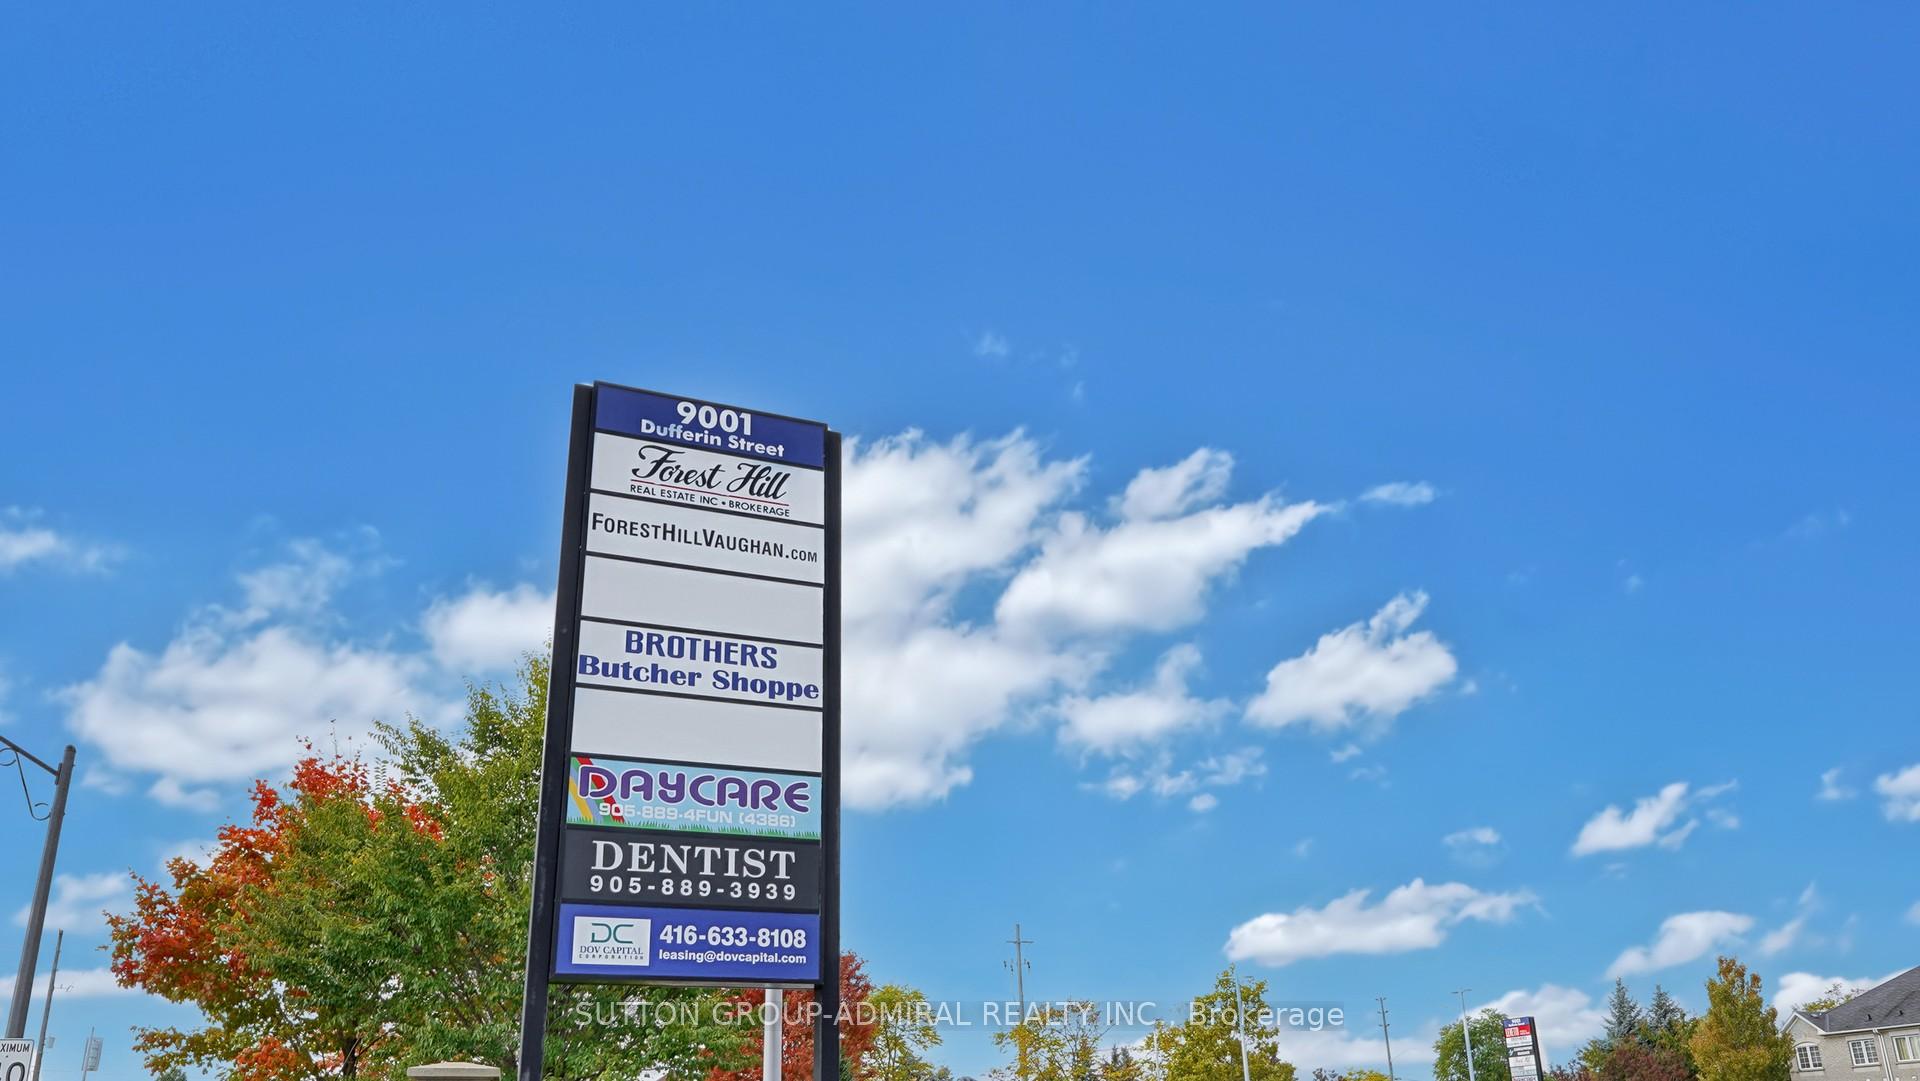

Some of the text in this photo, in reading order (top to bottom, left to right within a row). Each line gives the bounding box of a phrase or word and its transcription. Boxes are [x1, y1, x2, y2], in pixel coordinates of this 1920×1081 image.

[676, 401, 752, 436] 9001
[640, 418, 785, 458] Dufferin Street
[631, 444, 791, 500] Forest Hill
[630, 484, 790, 518] REAL ESTATE INC BROKERAGE
[625, 629, 778, 670] BROTHERS
[578, 654, 819, 701] Butcher Shoppe
[578, 764, 811, 814] DAYCARE
[598, 802, 797, 829] 905-889-4FUN (4386)
[591, 839, 797, 881] DENTIST
[589, 875, 797, 901] 905-889-3939
[579, 945, 644, 955] DOV CAPITAL
[659, 924, 808, 949] 416-633-8108
[658, 948, 808, 965] leasing@dovcapital.com
[0, 1043, 31, 1053] XIMUM
